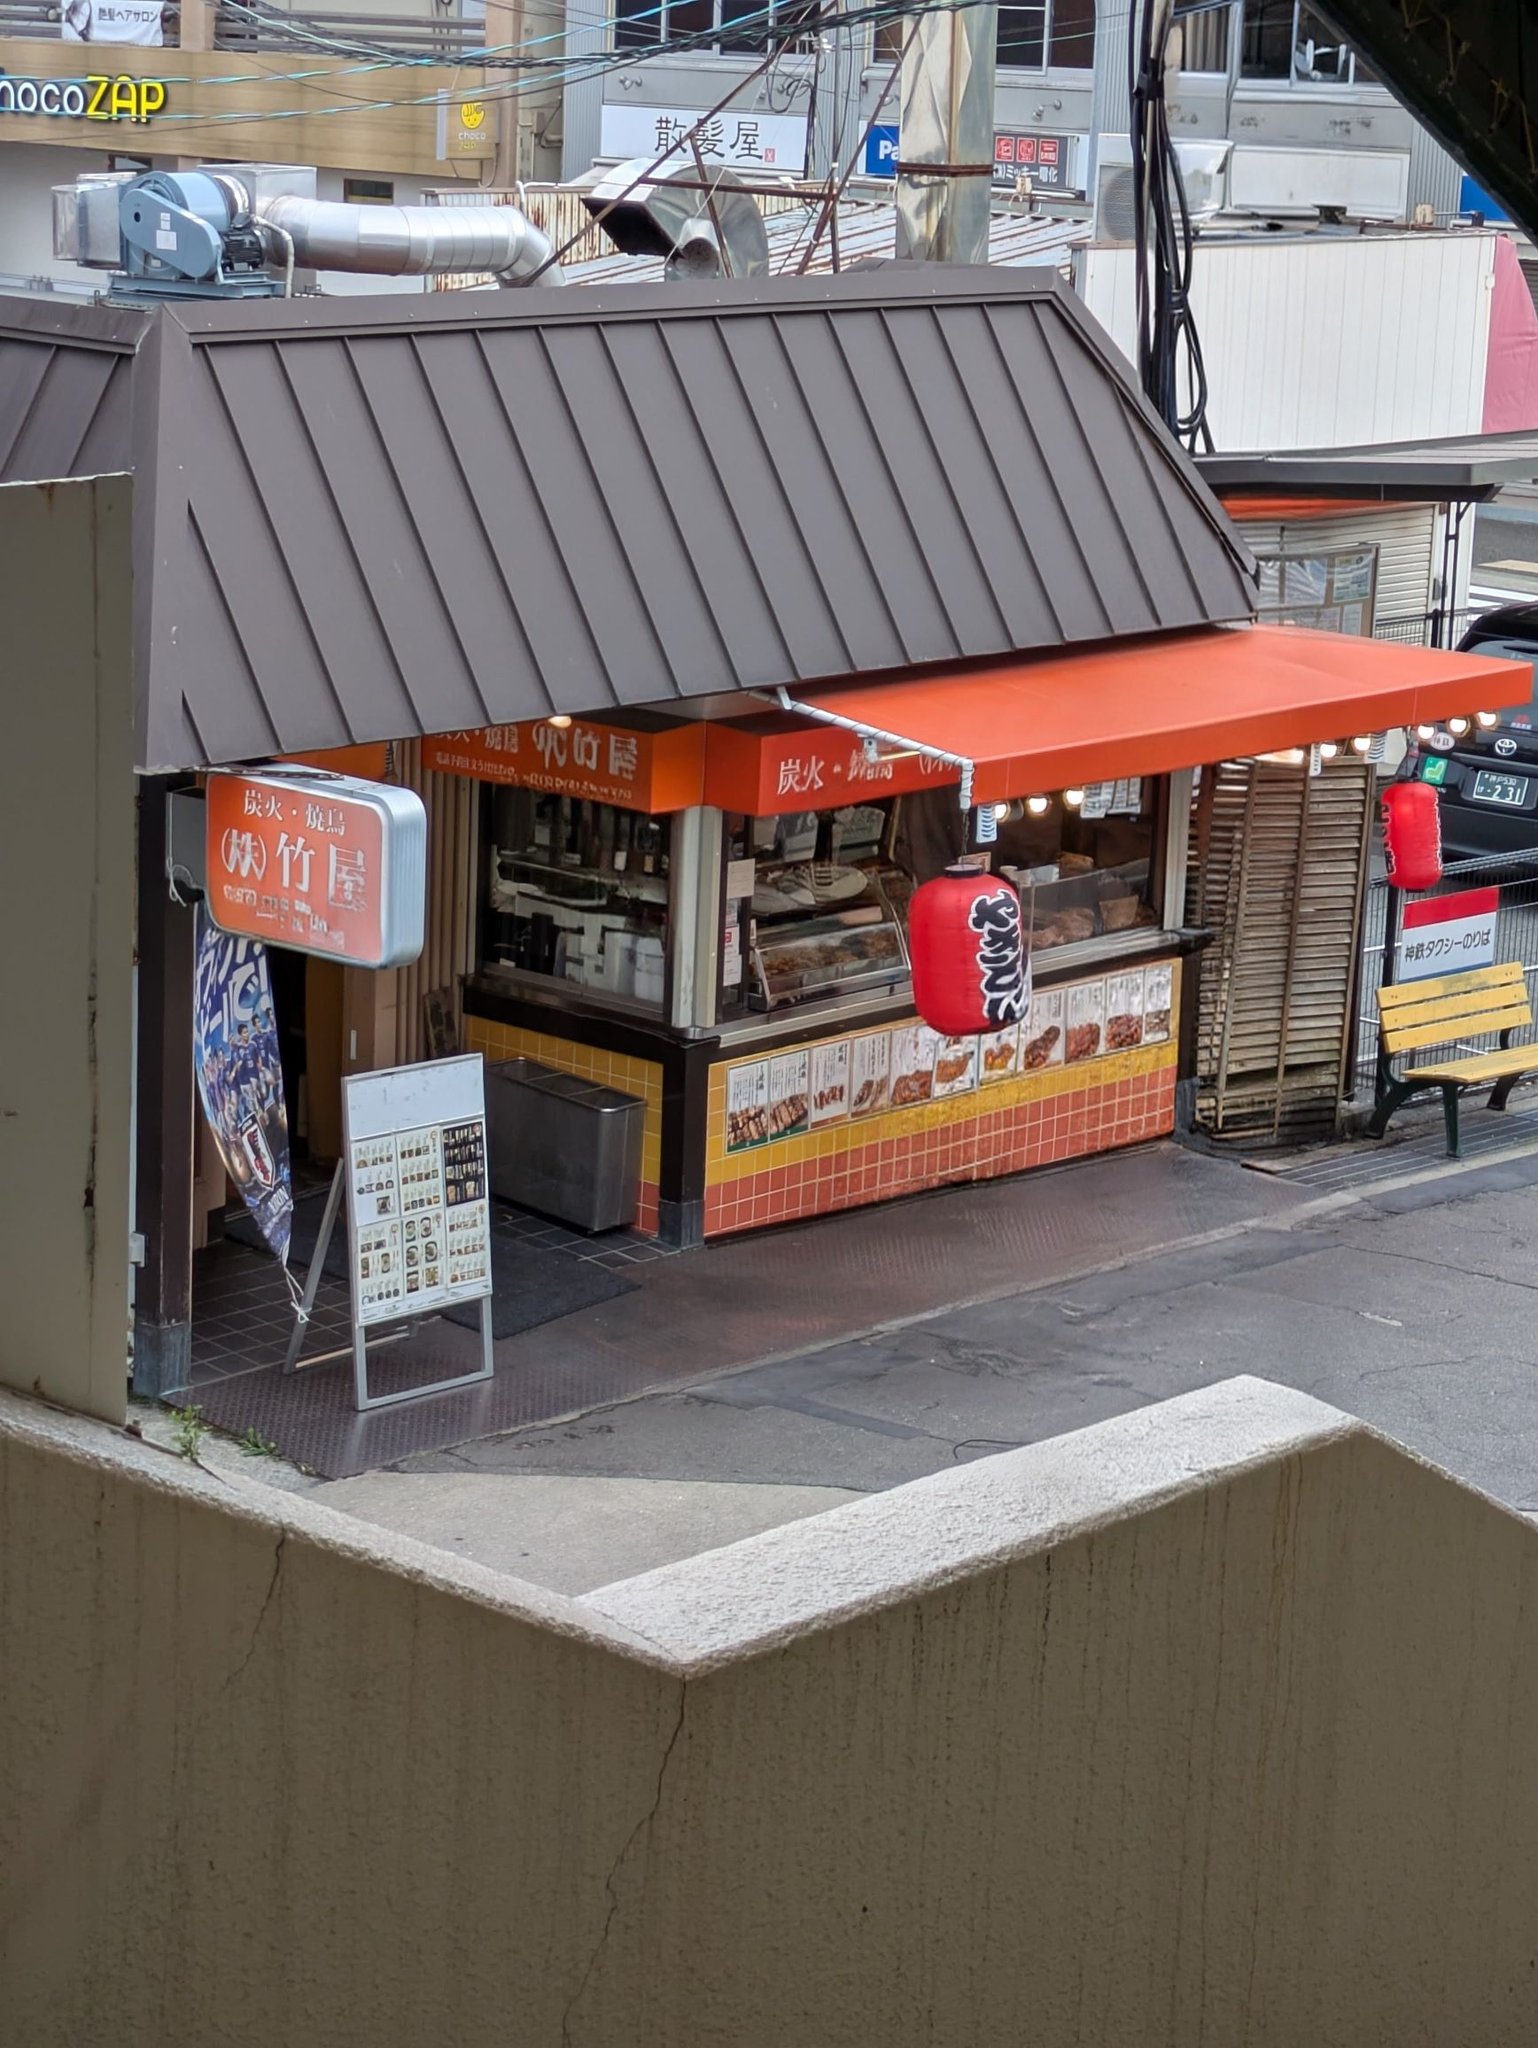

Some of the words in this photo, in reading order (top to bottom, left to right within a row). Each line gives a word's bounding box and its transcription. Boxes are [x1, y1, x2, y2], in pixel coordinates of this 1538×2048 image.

[655, 116, 763, 160] 散髪屋
[1404, 928, 1491, 963] 神鉄タクシーのりば
